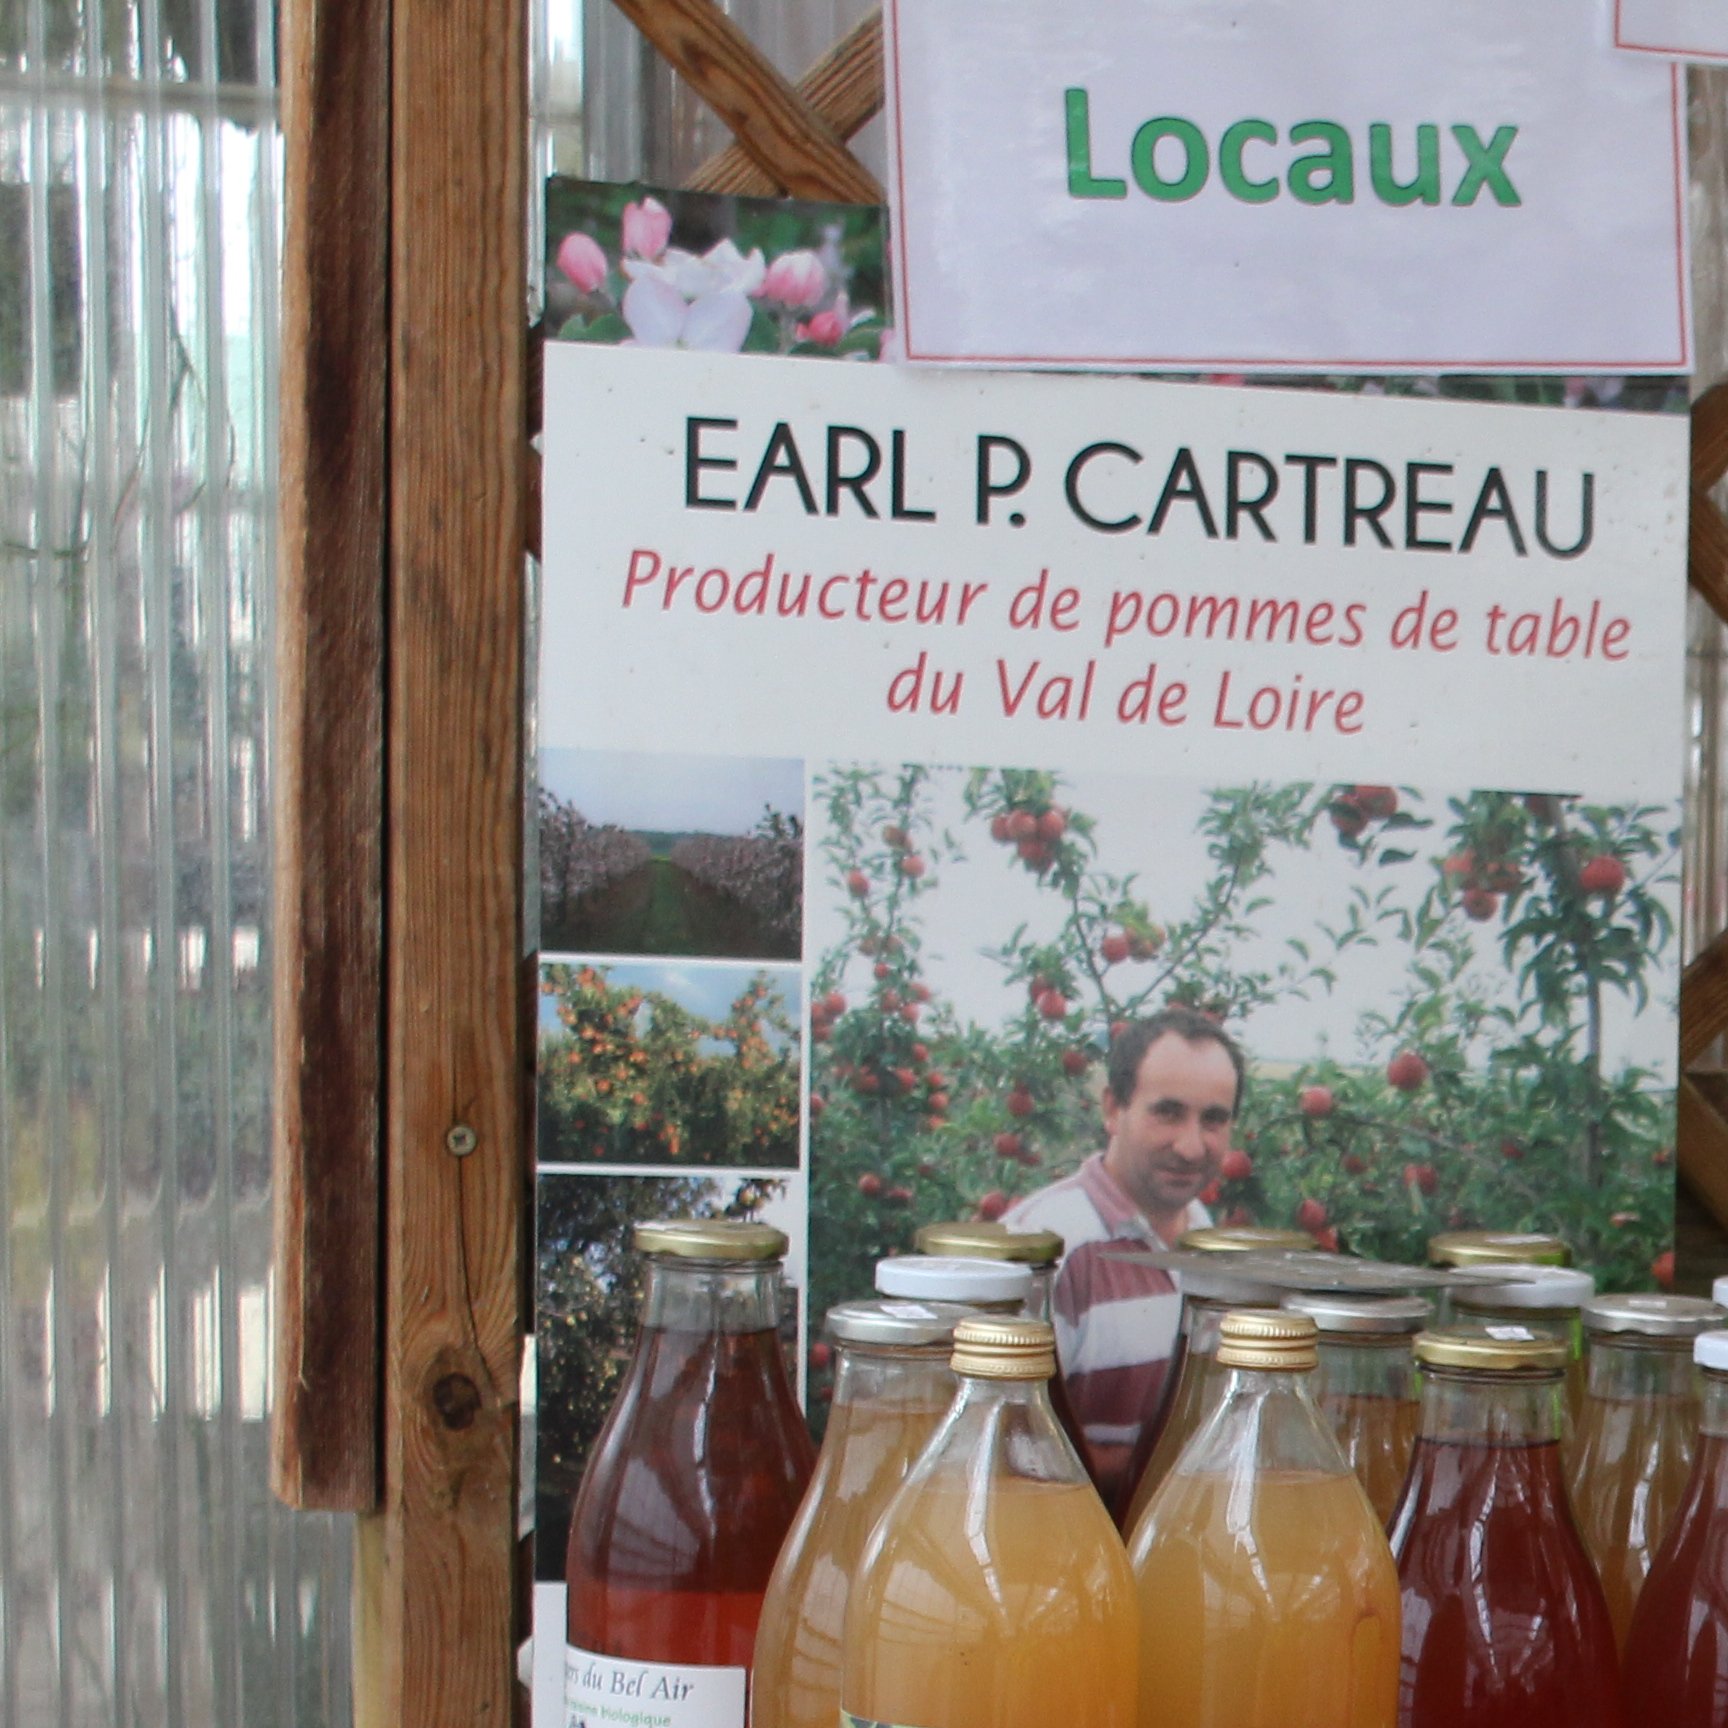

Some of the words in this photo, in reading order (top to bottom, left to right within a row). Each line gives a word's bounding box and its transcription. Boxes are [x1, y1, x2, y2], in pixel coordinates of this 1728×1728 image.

[1064, 88, 1522, 208] Locaux
[683, 416, 936, 524] EARL
[975, 436, 1029, 530] P.
[1064, 440, 1595, 559] CARTREAU
[621, 549, 987, 627] Producteur
[1008, 567, 1081, 633] de
[1103, 584, 1367, 650] pommes
[1389, 590, 1459, 653] de
[1484, 598, 1632, 662] table
[885, 652, 964, 717] du
[997, 658, 1092, 723] Val
[1116, 662, 1190, 727] de
[1213, 670, 1366, 736] Loire
[582, 1662, 603, 1692] du
[610, 1669, 648, 1697] Bel
[650, 1676, 694, 1701] Air
